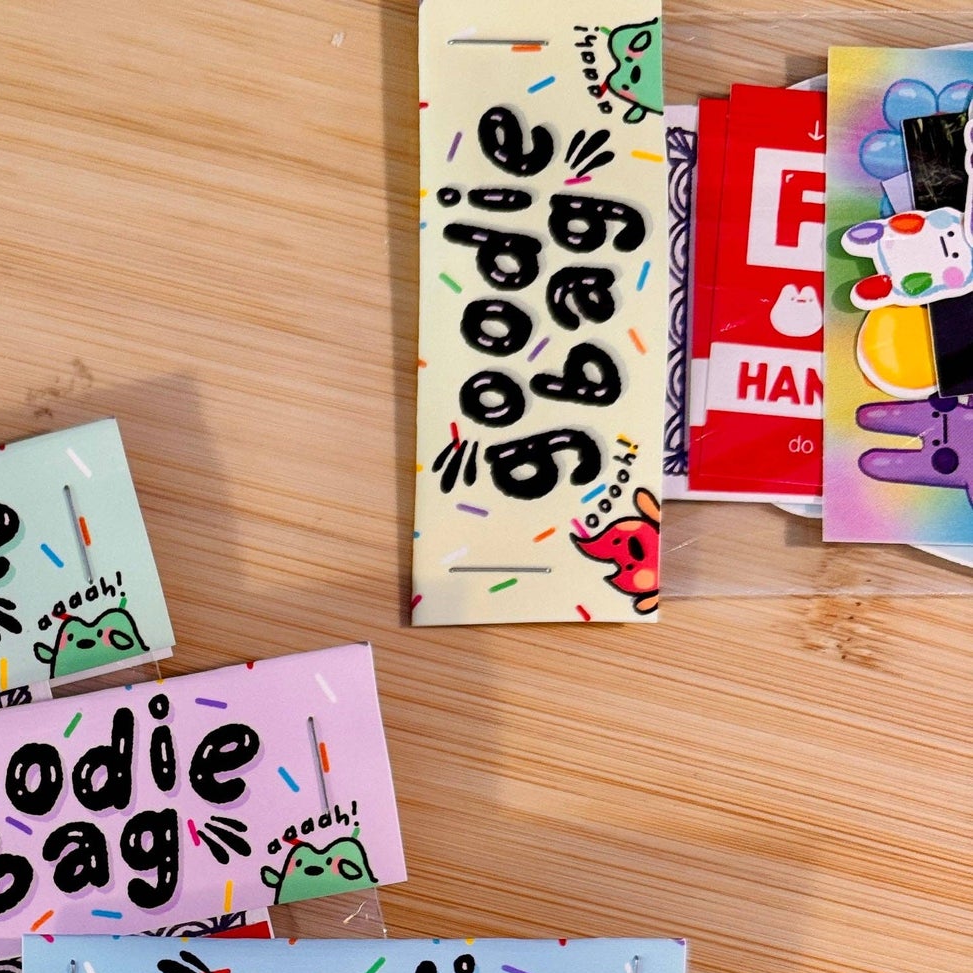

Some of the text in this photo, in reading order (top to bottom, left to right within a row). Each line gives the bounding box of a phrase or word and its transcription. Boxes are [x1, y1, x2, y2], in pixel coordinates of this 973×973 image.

[437, 106, 602, 501] goodie
[529, 193, 646, 407] bag
[788, 435, 815, 455] do
